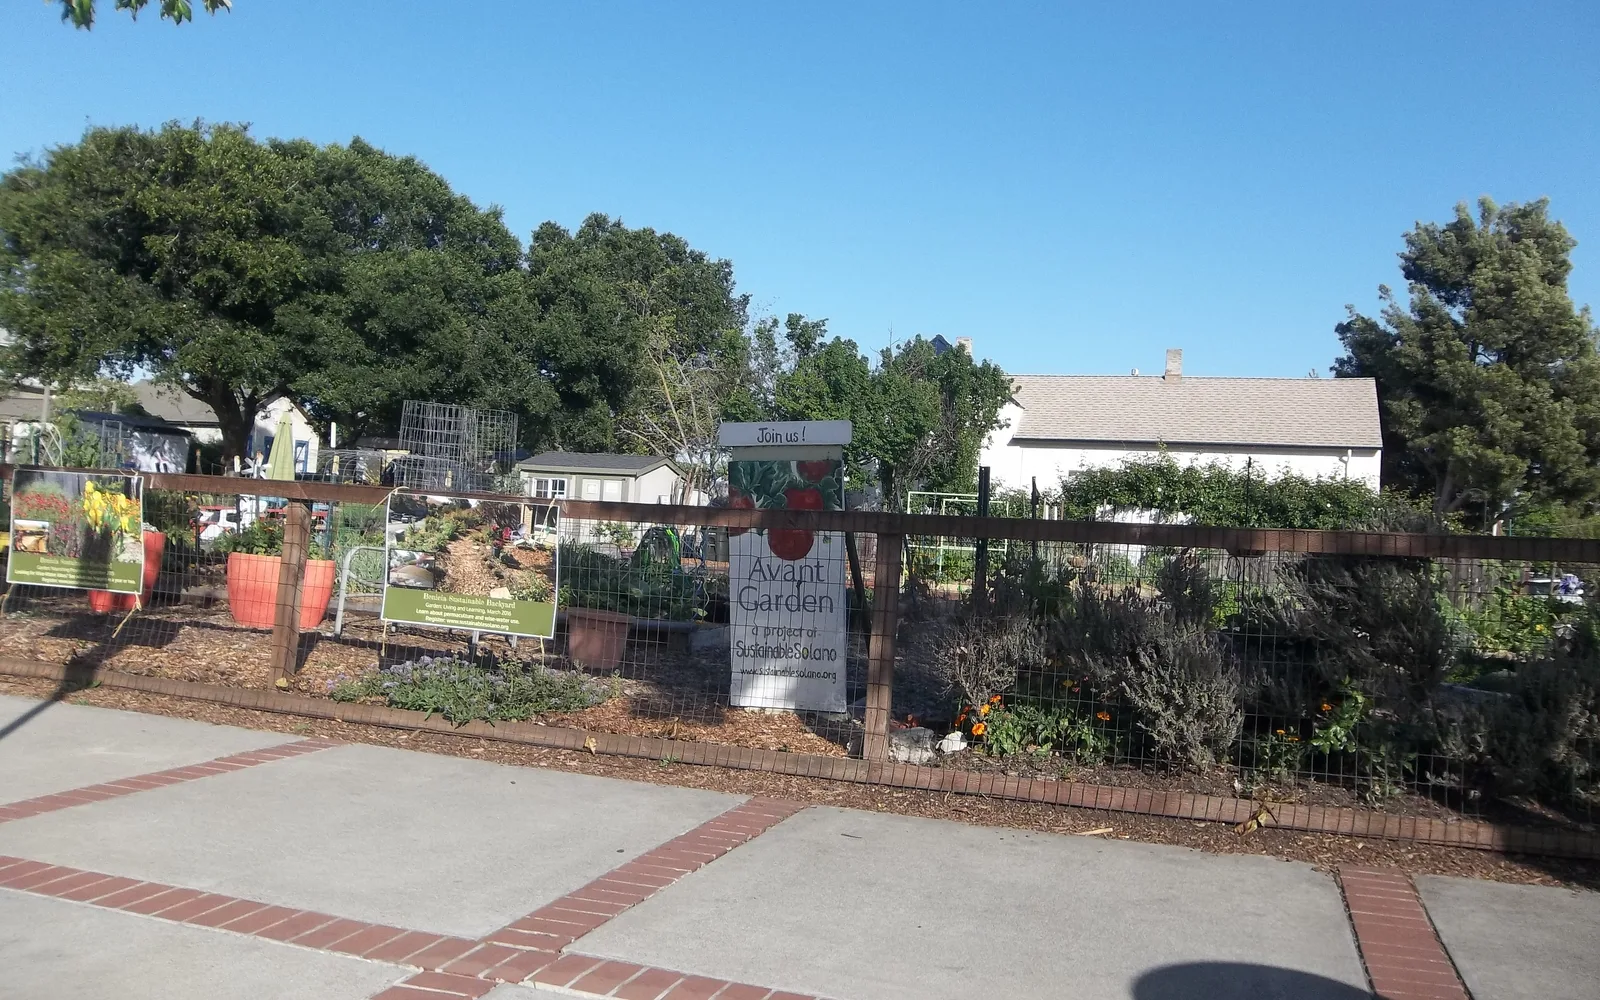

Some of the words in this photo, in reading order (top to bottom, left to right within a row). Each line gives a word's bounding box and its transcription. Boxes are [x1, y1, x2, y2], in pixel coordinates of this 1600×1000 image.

[757, 427, 783, 443] Join
[748, 557, 825, 582] Avant
[423, 593, 447, 602] Benicia
[448, 595, 485, 605] Sustainable
[486, 599, 516, 609] Backyard
[739, 583, 834, 613] Garden
[443, 603, 457, 611] Living
[443, 611, 475, 619] permaculture
[752, 626, 758, 636] a
[763, 626, 803, 641] project
[736, 640, 837, 661] SustainableSolano
